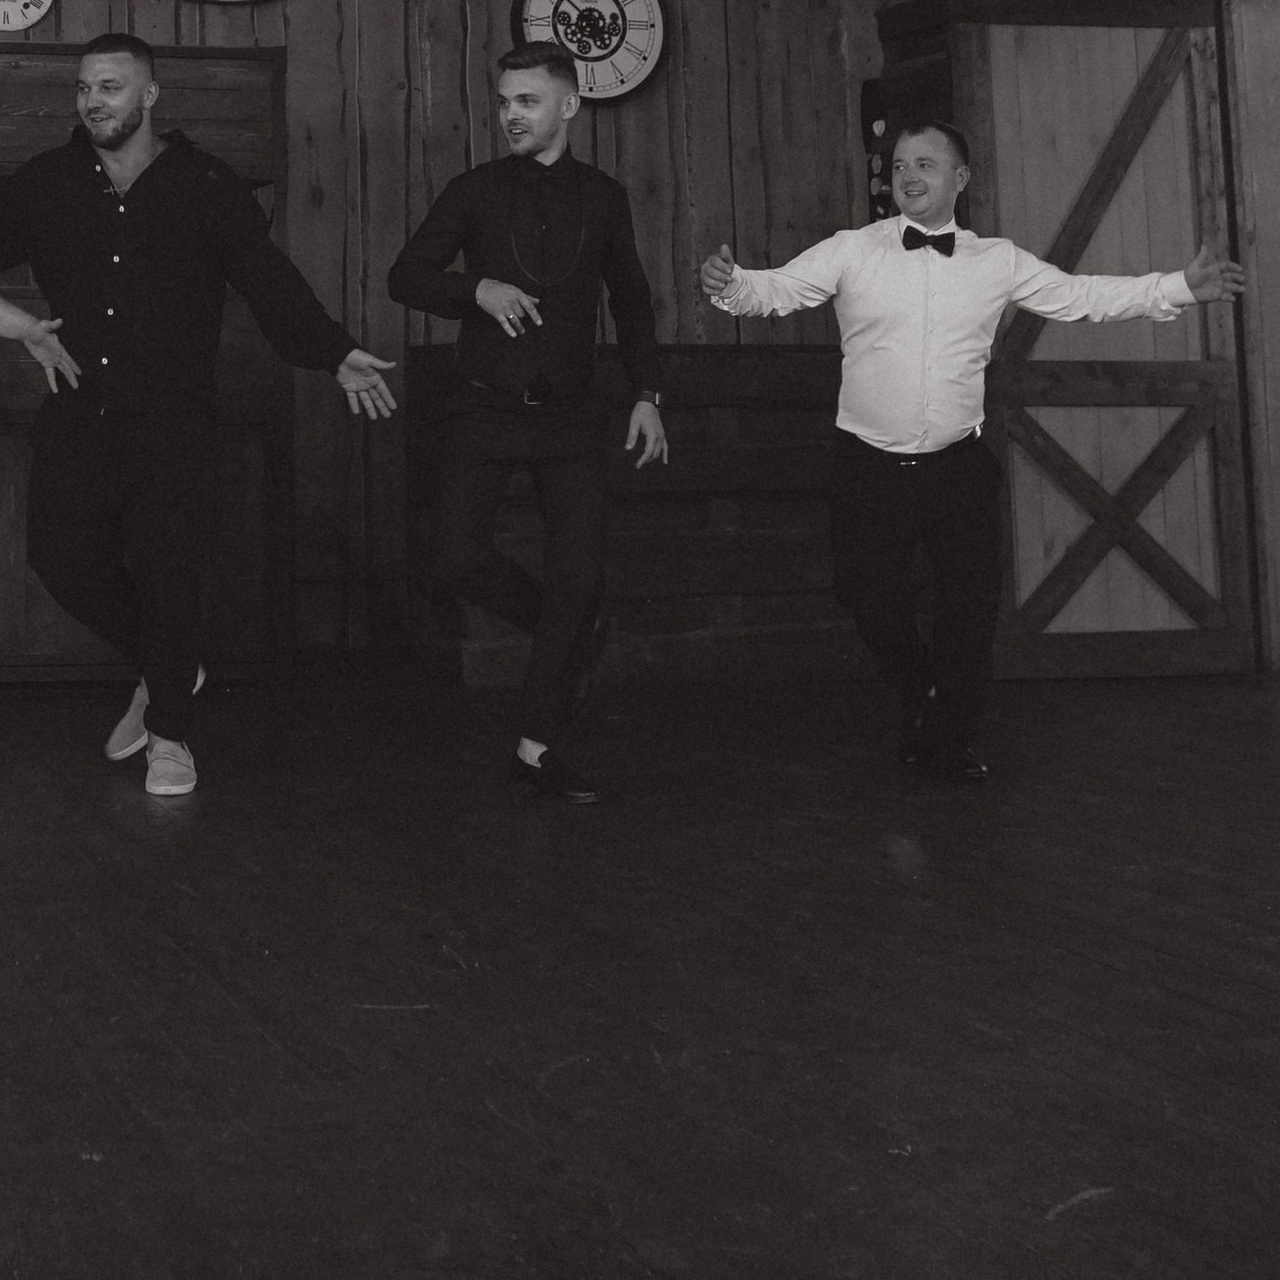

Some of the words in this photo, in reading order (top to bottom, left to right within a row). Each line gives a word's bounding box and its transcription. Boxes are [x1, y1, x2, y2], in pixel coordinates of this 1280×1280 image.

[530, 15, 550, 26] IX
[628, 21, 648, 30] III
[624, 41, 643, 60] IV
[585, 64, 596, 85] VI
[610, 60, 623, 79] V
